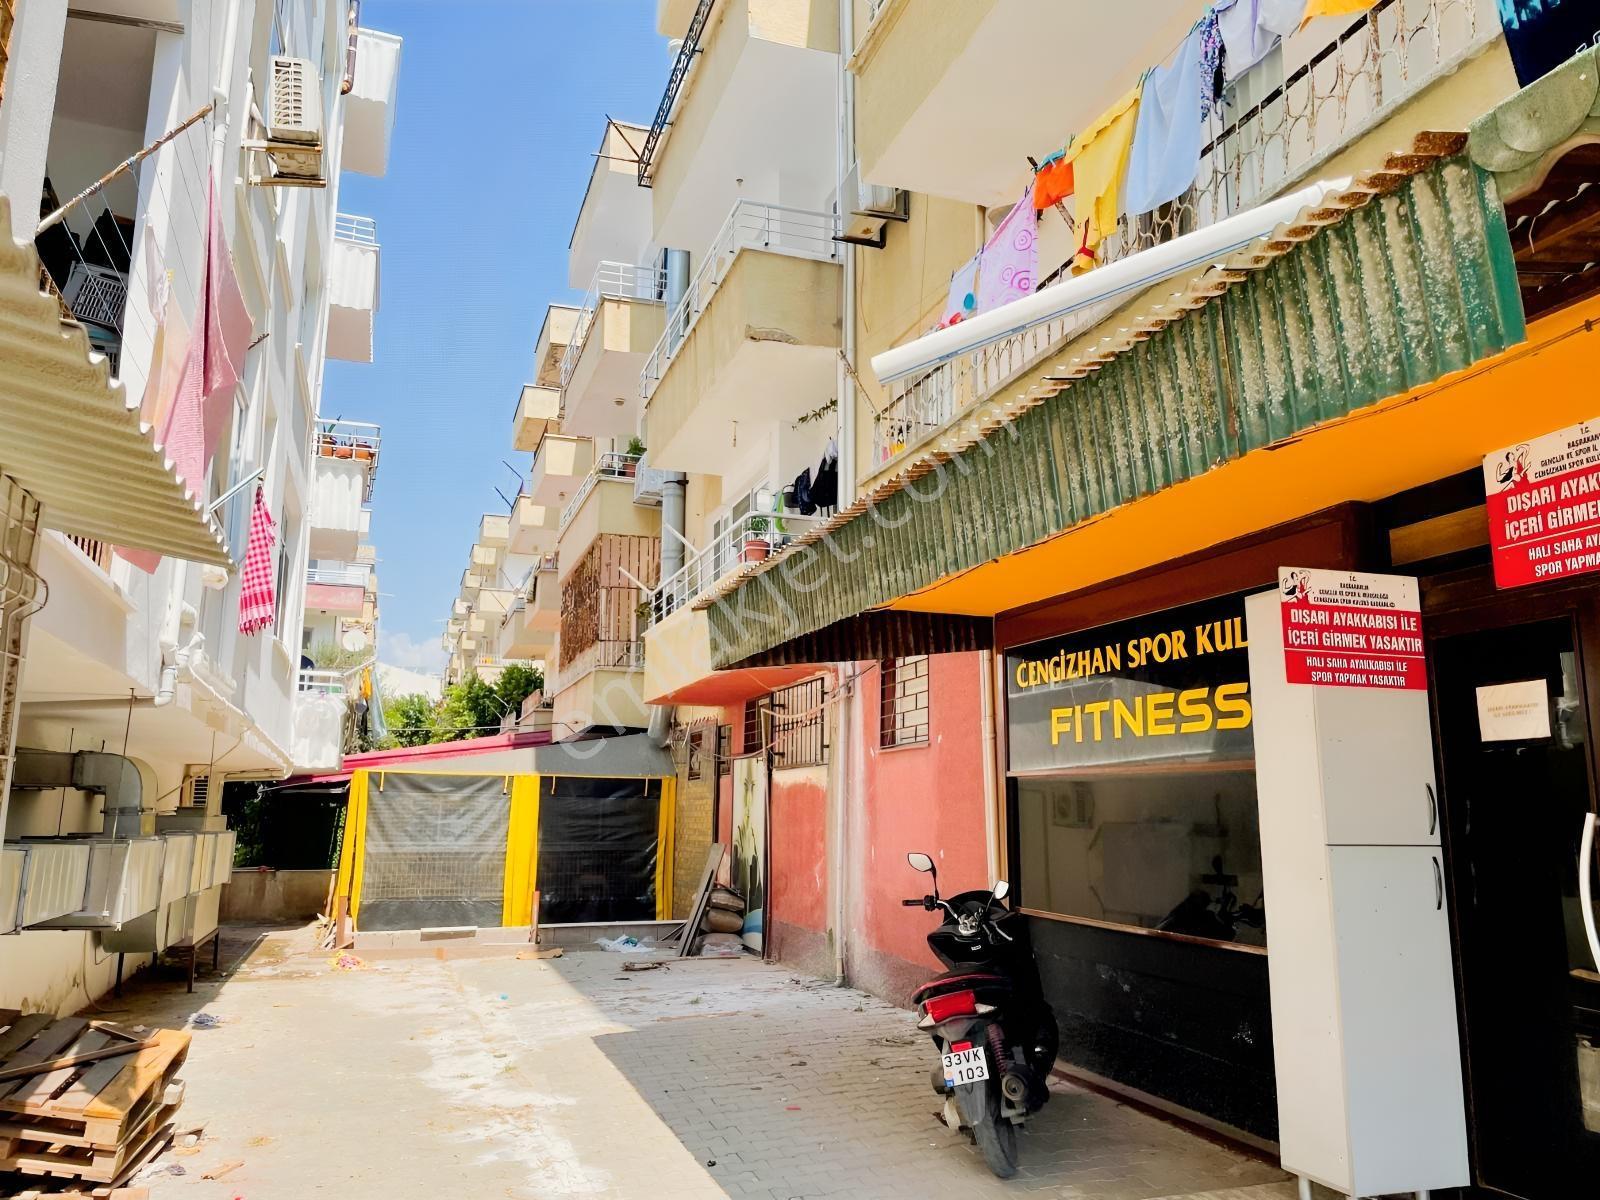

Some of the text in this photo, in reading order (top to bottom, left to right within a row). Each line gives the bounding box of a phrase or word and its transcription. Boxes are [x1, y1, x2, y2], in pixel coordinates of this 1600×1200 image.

[1506, 471, 1600, 514] DIŞARI AYAK
[1505, 511, 1544, 541] İÇERİ
[1528, 544, 1552, 561] HALI
[1554, 537, 1583, 555] SAHA
[1535, 560, 1562, 577] SPOR
[1290, 608, 1418, 632] DIŞARI AYAKKABISI İLE
[1288, 626, 1423, 653] İÇERİ GİRMEK YASAKTIR
[1016, 642, 1121, 689] CENGİZHAN
[1127, 629, 1189, 669] SPOR
[1311, 671, 1333, 683] SPOR
[1051, 682, 1252, 745] FITNESS
[958, 1066, 985, 1082] 103
